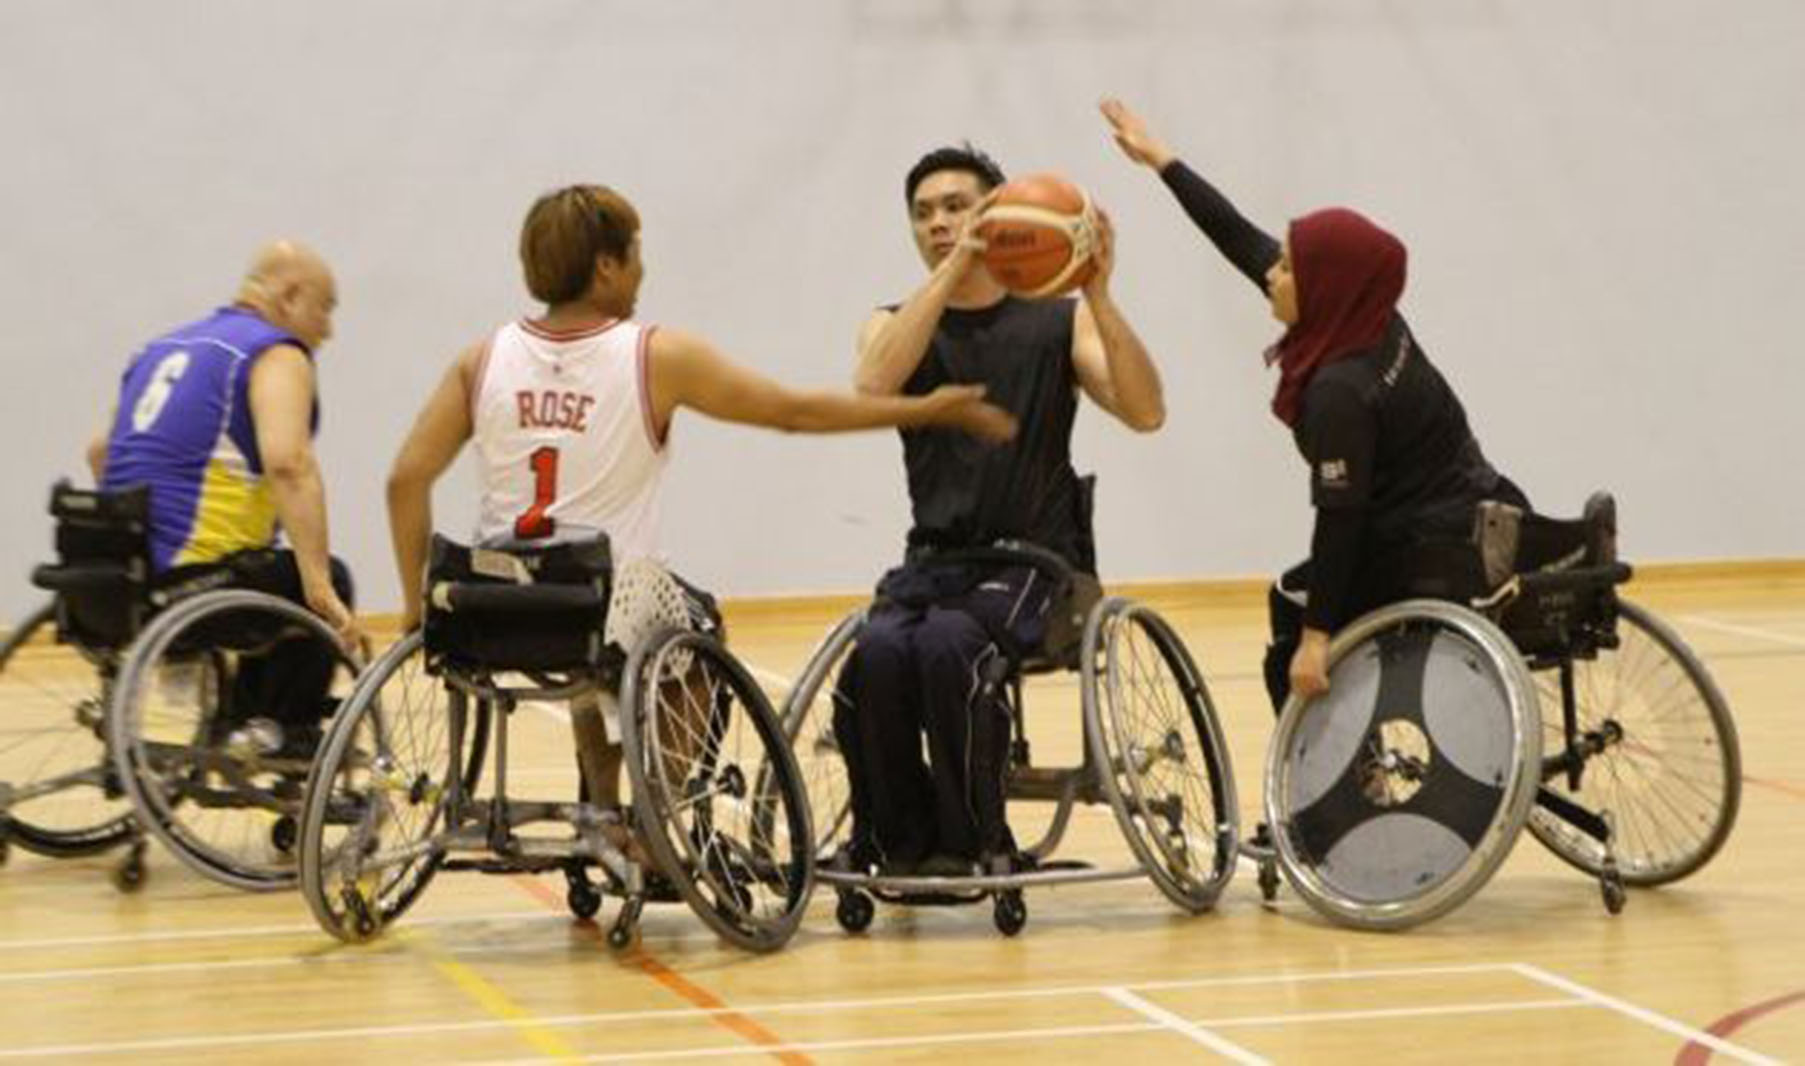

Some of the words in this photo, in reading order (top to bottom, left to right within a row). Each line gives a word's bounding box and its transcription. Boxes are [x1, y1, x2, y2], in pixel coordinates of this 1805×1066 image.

[133, 350, 190, 433] 6
[516, 389, 596, 433] ROSE
[514, 446, 560, 540] 1
